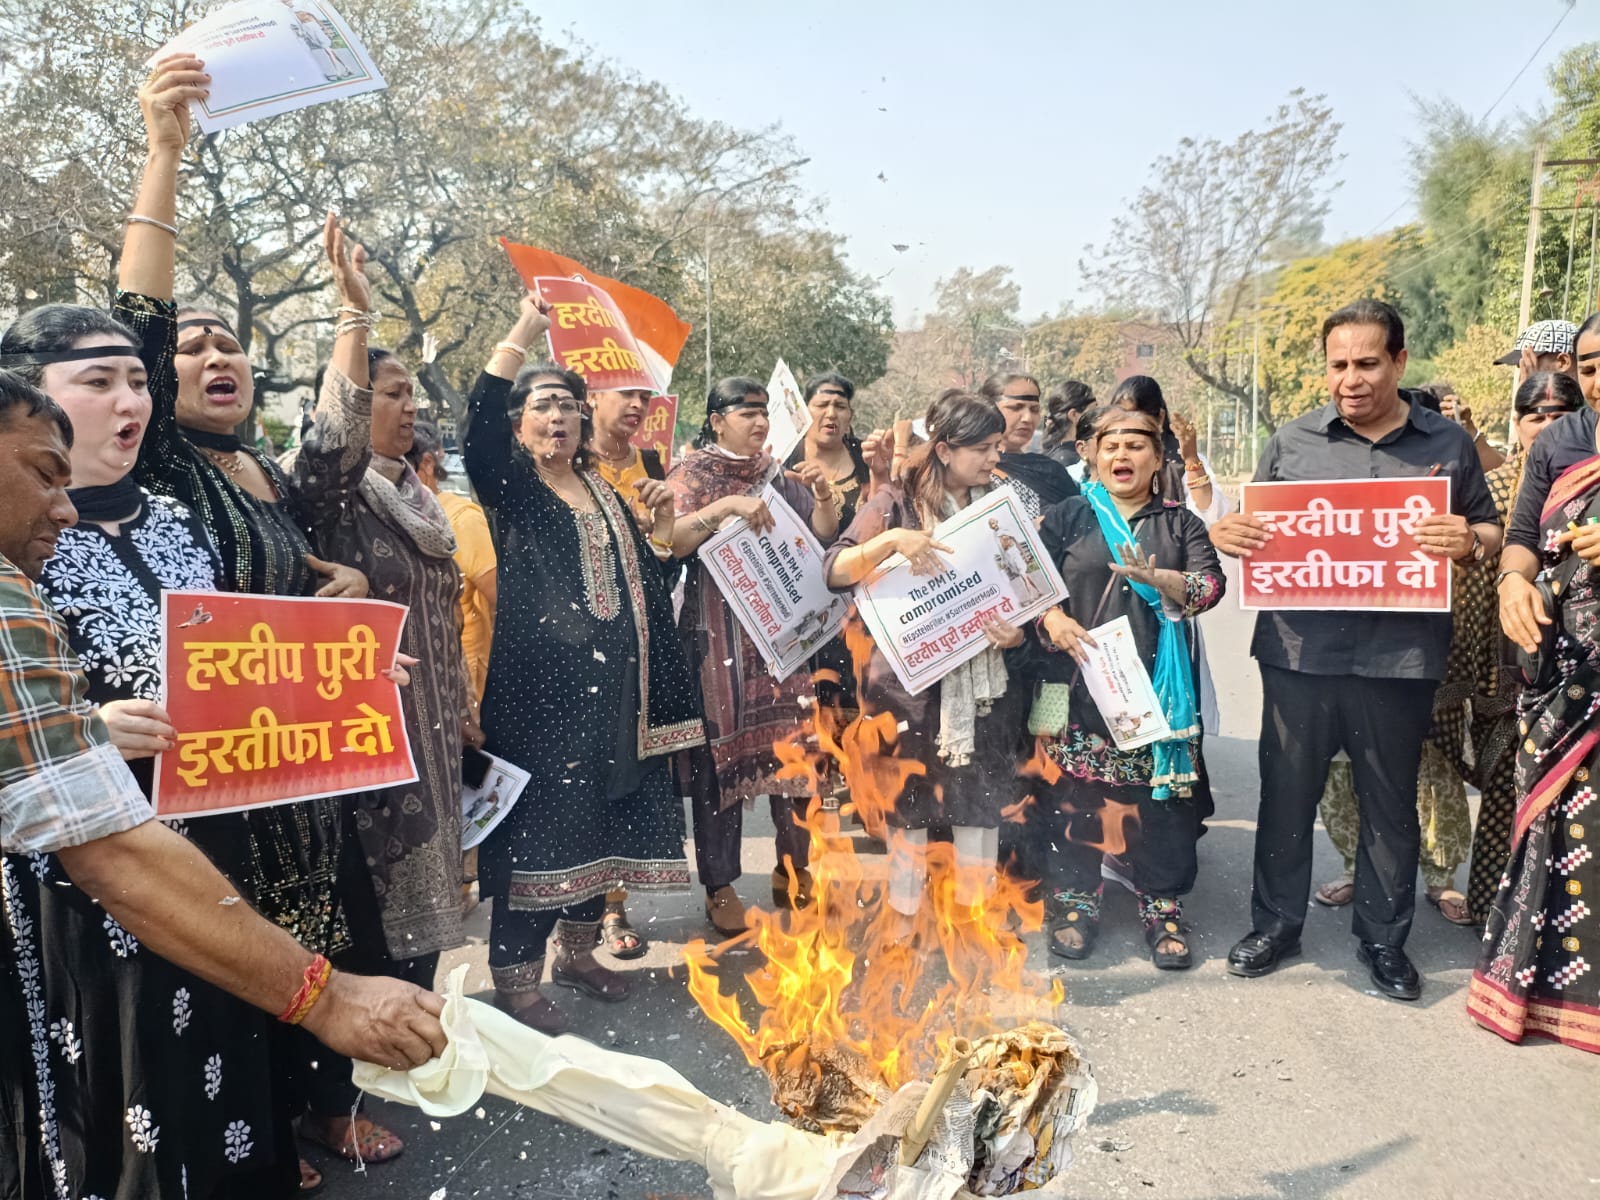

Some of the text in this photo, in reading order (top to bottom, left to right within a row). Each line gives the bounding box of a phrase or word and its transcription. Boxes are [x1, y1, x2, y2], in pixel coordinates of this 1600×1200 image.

[643, 405, 670, 442] पुरी
[1252, 495, 1436, 548] हरदीप पुरी
[758, 536, 803, 604] compromised
[777, 540, 793, 560] The
[786, 558, 798, 576] PM
[793, 569, 804, 582] is
[908, 569, 957, 602] The PM is
[1249, 549, 1440, 594] इस्तीफा दो
[718, 543, 745, 576] हरदीप
[732, 574, 754, 597] पुरी
[768, 622, 782, 637] दो
[899, 570, 983, 625] compromised
[945, 585, 998, 619] #SurrenderModi
[904, 640, 941, 668] हरदीप
[938, 625, 961, 653] पुरी
[999, 596, 1014, 613] दो
[183, 622, 381, 700] हरदीप पुरी
[176, 702, 395, 788] इस्तीफा दो
